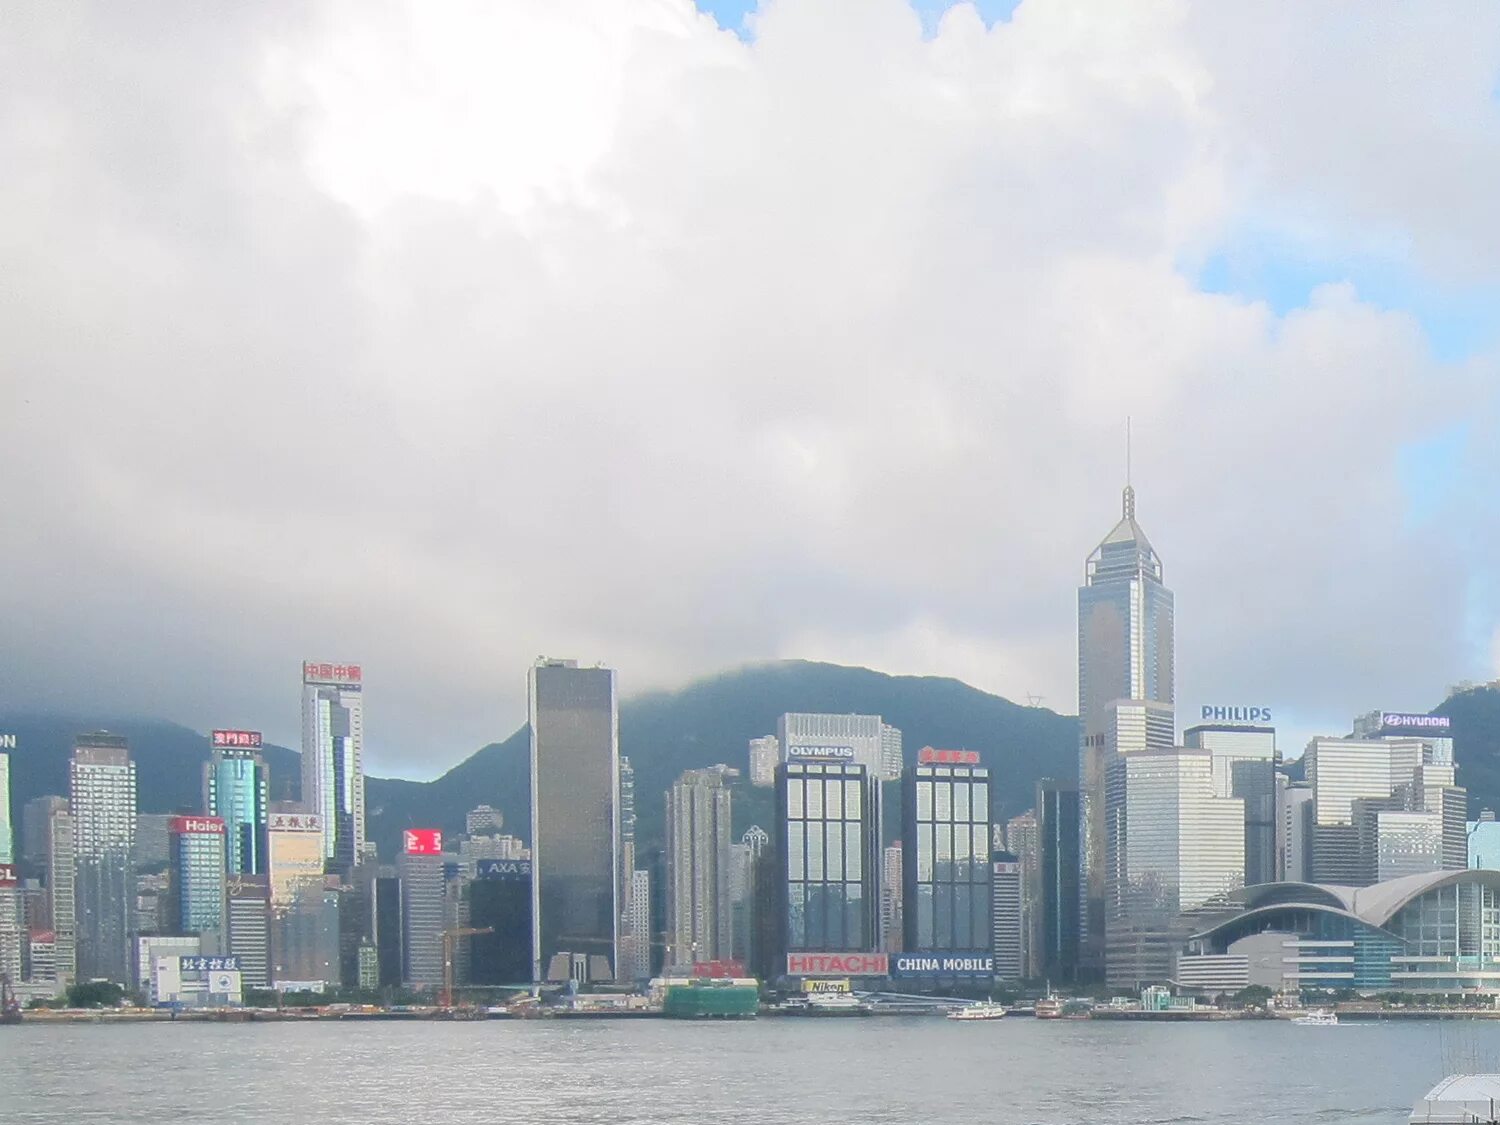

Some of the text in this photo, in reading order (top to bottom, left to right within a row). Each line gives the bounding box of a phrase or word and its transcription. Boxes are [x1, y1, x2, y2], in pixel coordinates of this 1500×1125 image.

[1202, 705, 1271, 721] PHILIPS
[1402, 716, 1450, 727] HYUNDAI
[790, 746, 853, 757] OLYMPUS
[185, 820, 225, 831] Haier
[489, 863, 518, 873] AXA
[789, 955, 887, 974] HITACHI
[897, 957, 993, 971] CHINA MOBILE
[811, 981, 845, 993] Nikon
